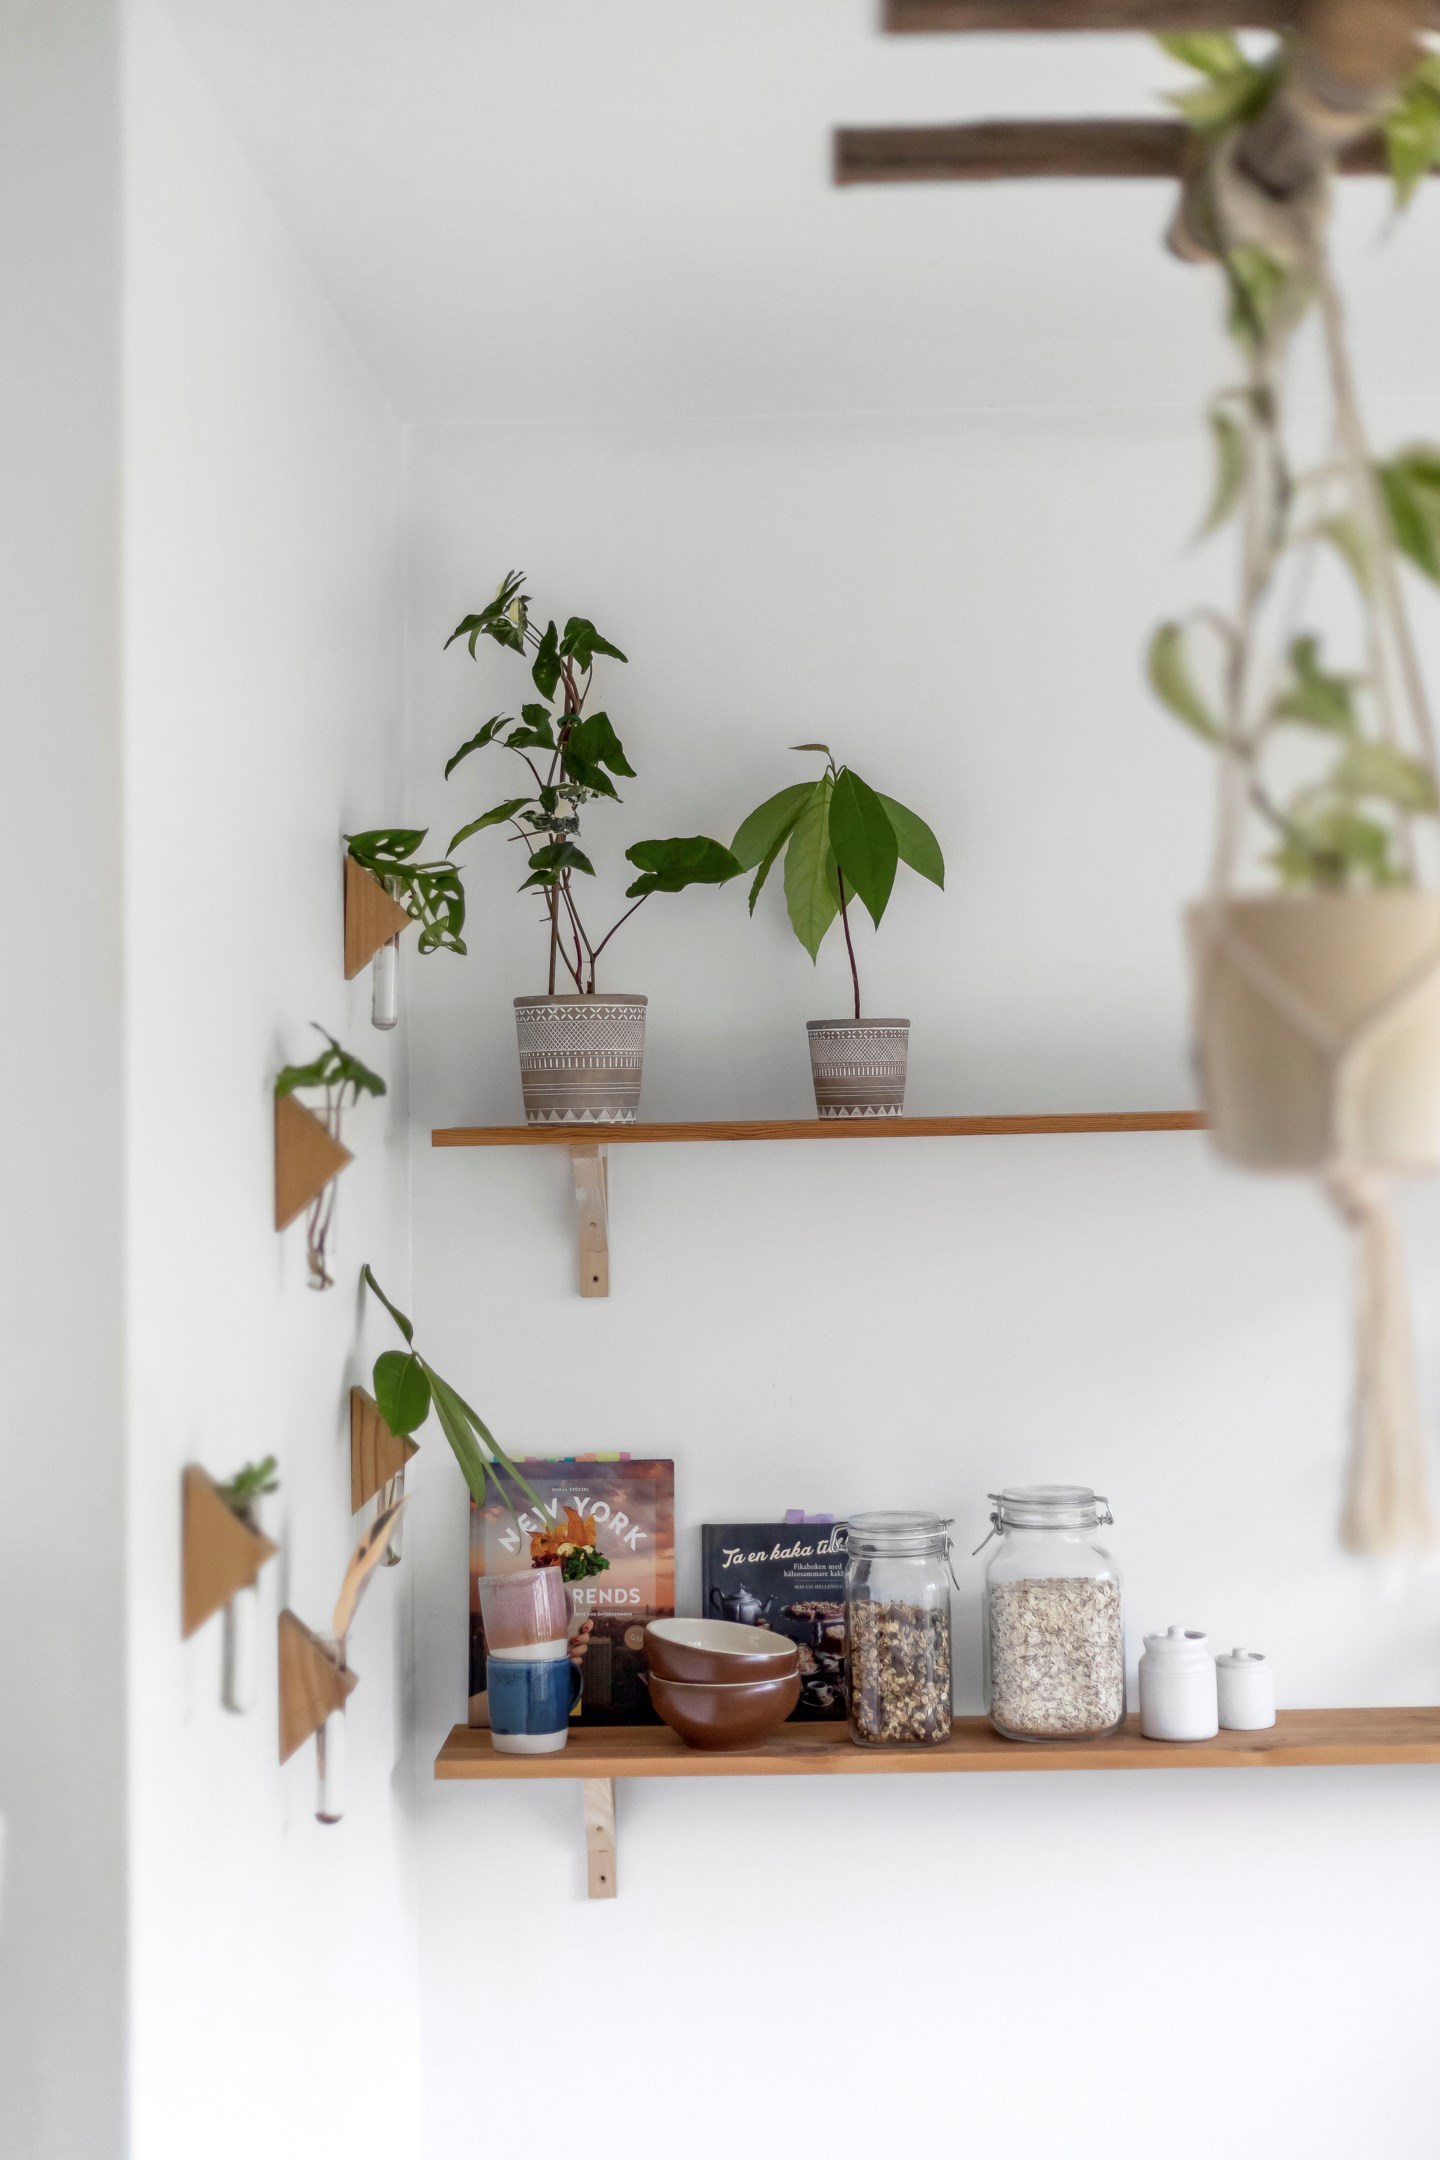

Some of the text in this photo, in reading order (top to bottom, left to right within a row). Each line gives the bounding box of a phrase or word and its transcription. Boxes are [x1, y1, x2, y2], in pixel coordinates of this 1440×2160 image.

[498, 1496, 648, 1552] NEW YORK
[722, 1547, 746, 1569] Ta
[748, 1551, 768, 1562] en
[770, 1540, 814, 1561] kaka
[793, 1562, 843, 1570] Fikaboken med
[572, 1588, 641, 1604] RENDS
